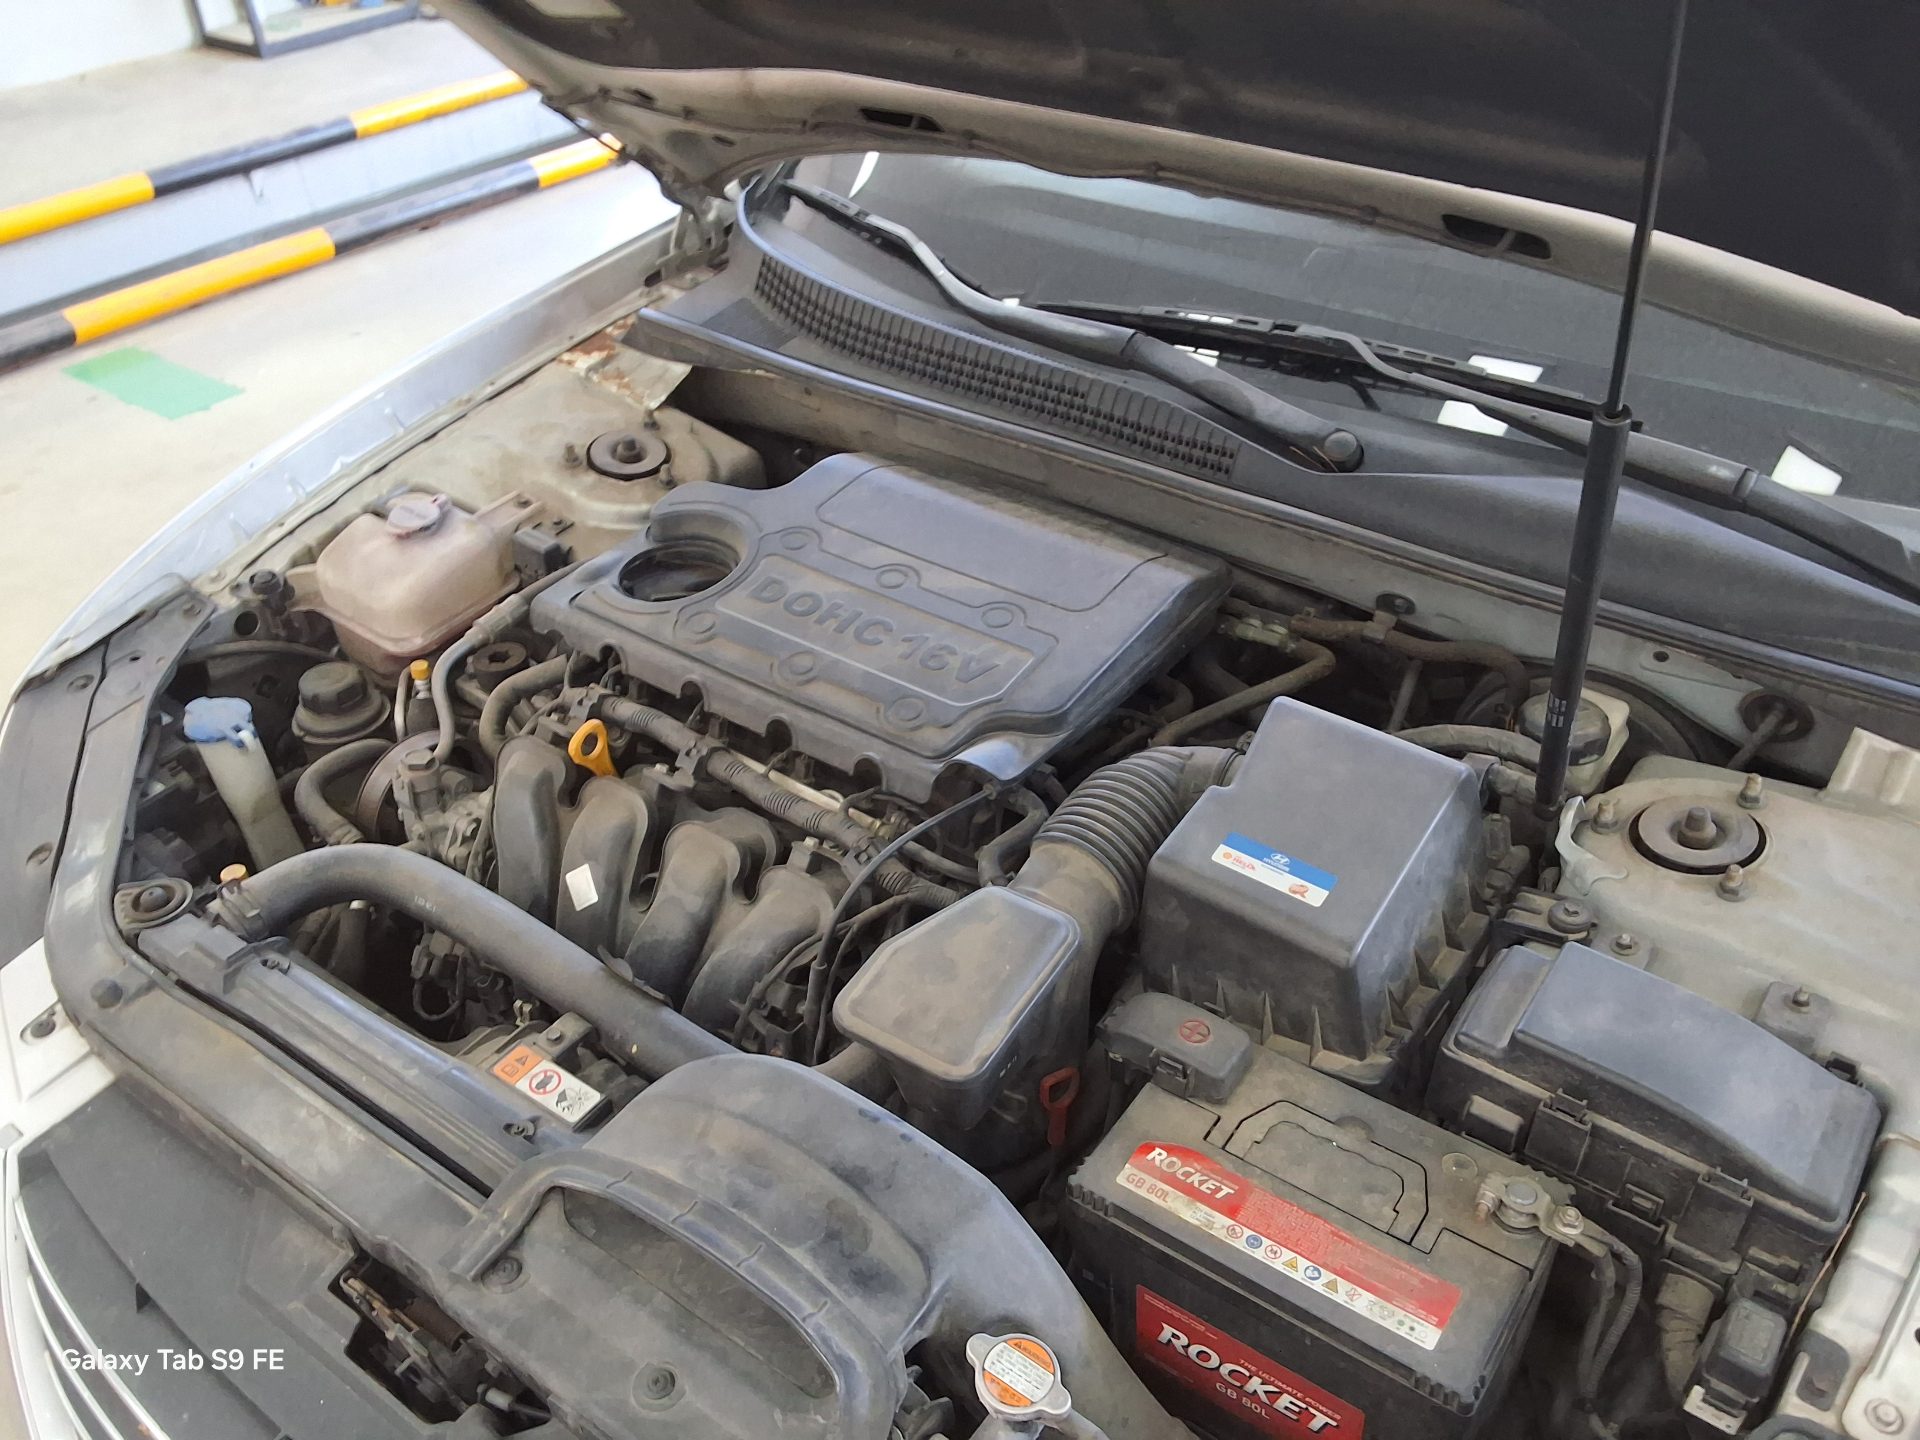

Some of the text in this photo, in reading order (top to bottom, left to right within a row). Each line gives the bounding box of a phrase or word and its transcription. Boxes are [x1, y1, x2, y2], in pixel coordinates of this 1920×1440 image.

[748, 575, 1001, 684] DOHC 16V
[1126, 1173, 1170, 1204] GB 80L
[1145, 1147, 1235, 1200] ROCKET
[1157, 1321, 1338, 1433] ROCKET
[1216, 1382, 1271, 1419] GB 80L
[1240, 1359, 1342, 1421] THE ULTIMATE POWER
